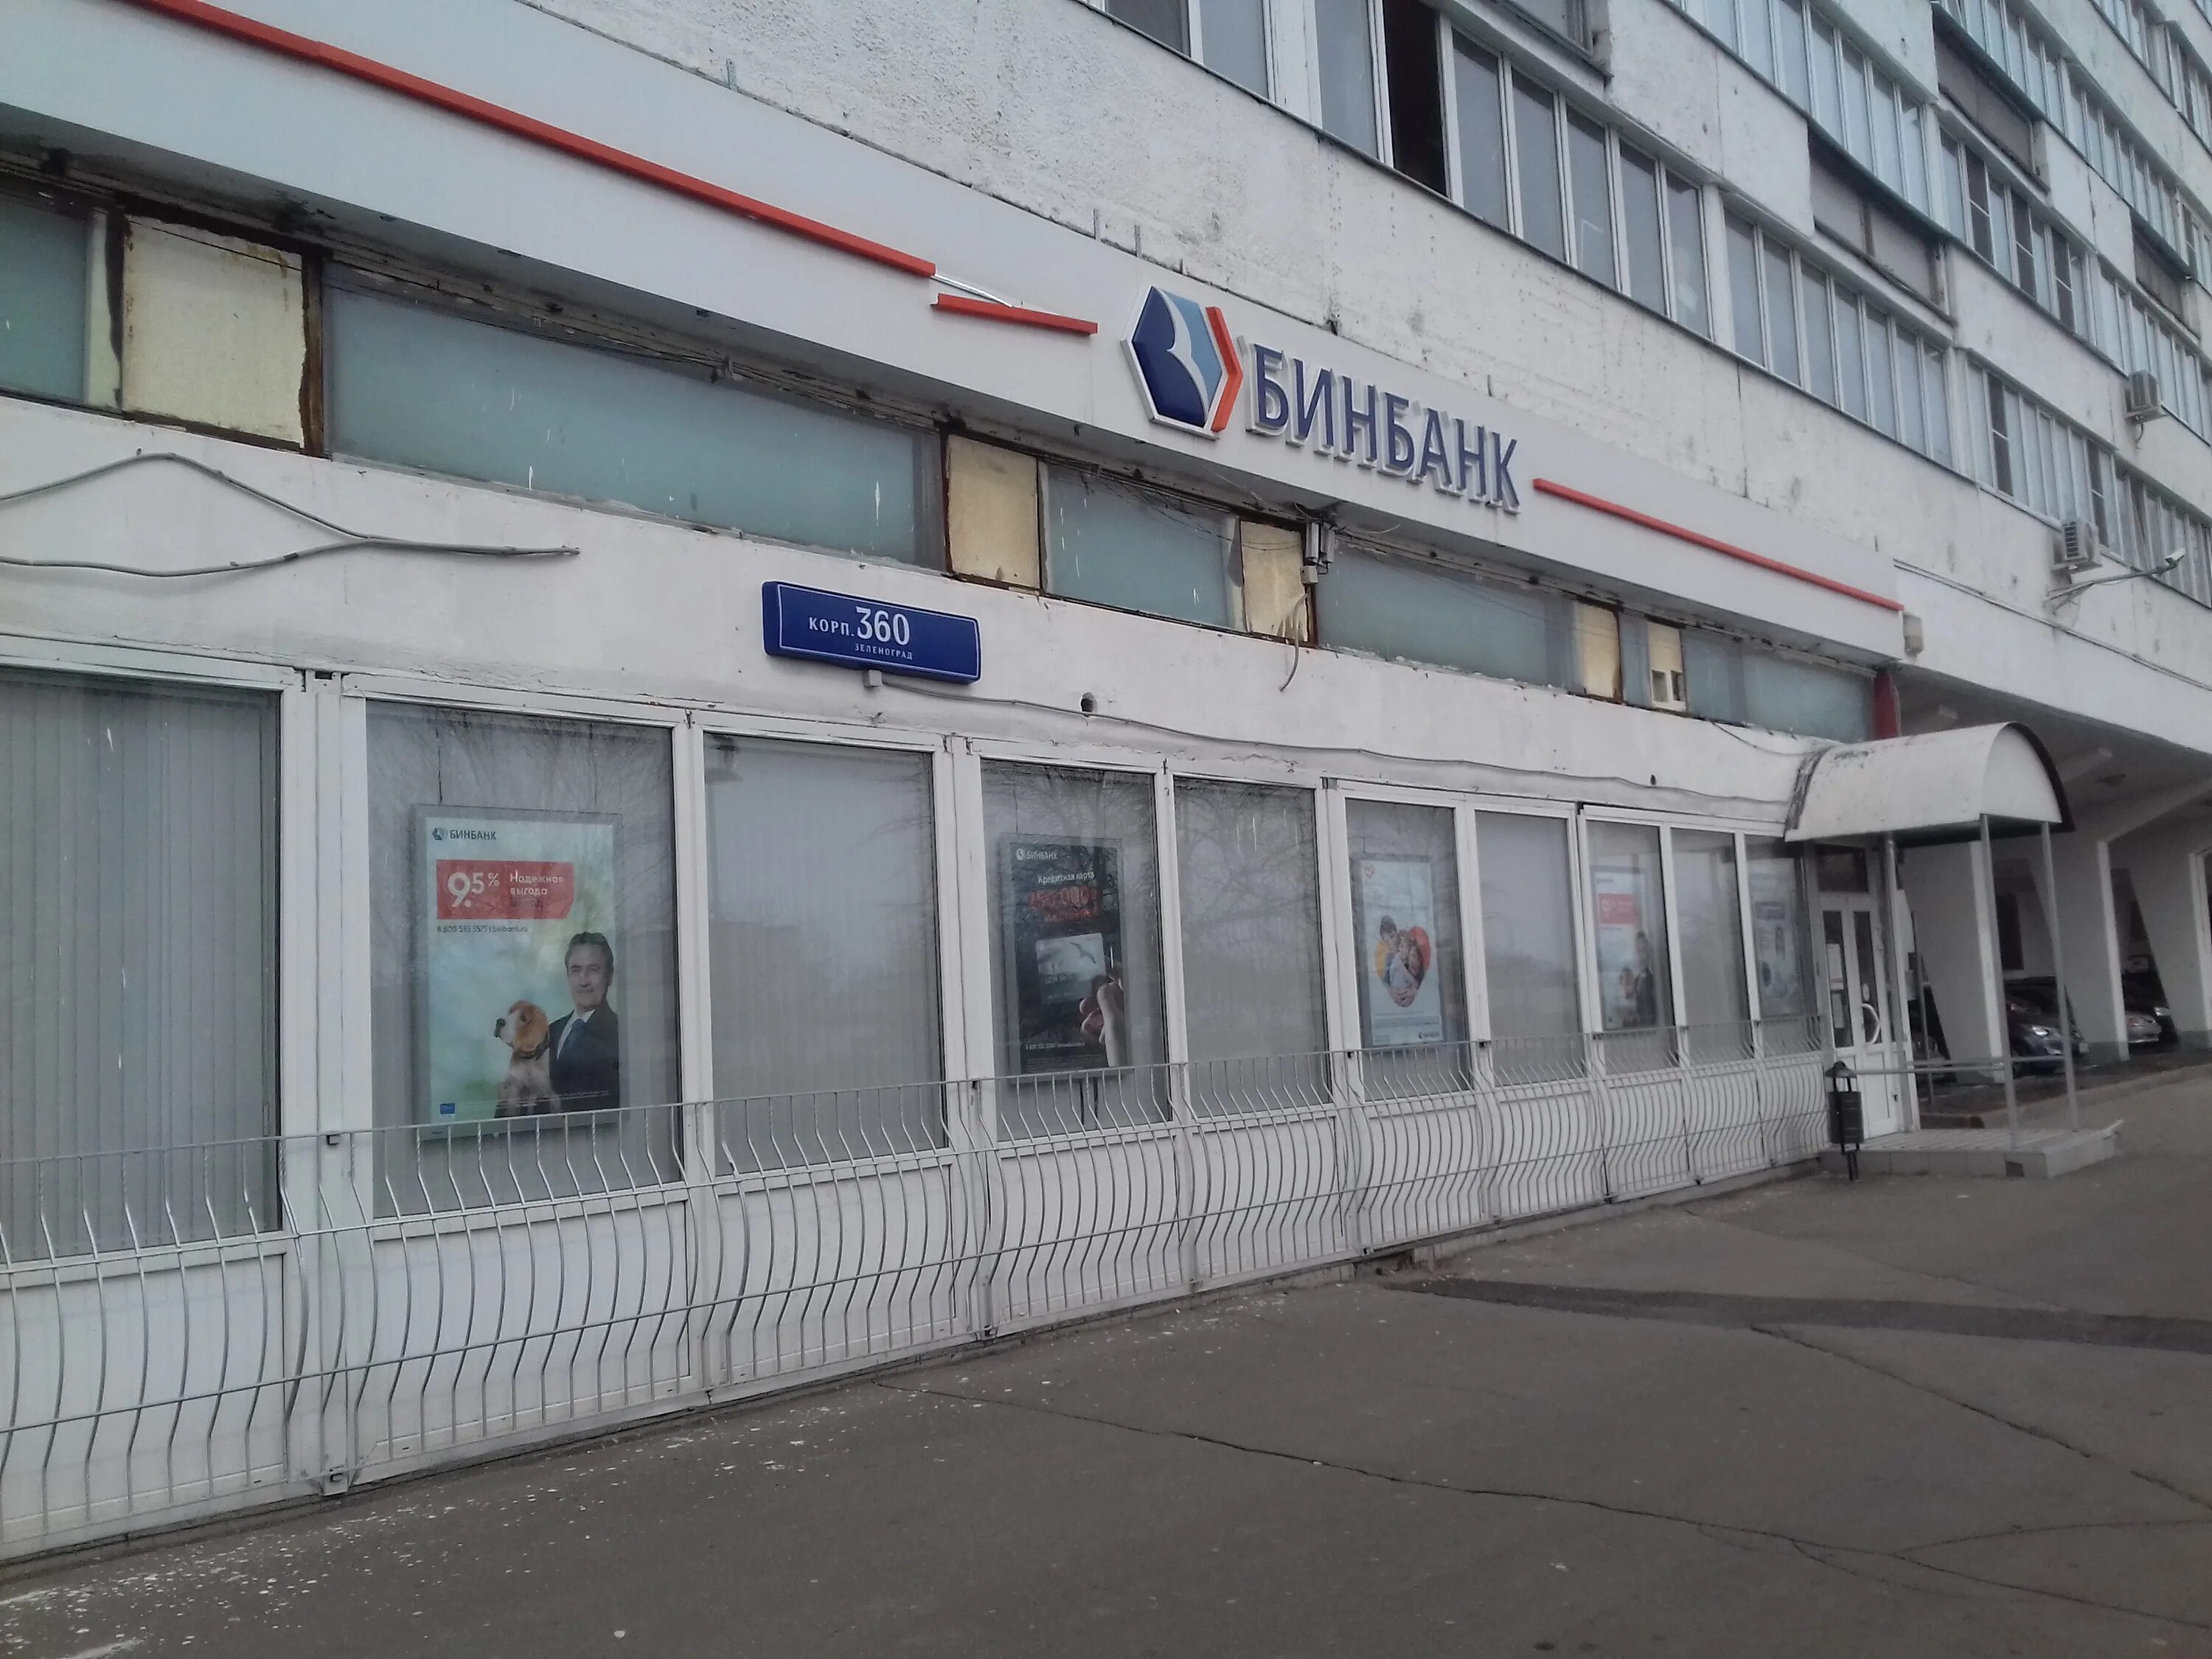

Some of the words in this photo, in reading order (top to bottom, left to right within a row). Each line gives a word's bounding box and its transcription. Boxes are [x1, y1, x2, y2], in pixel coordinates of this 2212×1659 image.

[1249, 342, 1522, 513] БИНБАНК
[809, 616, 855, 637] КОРП.
[856, 605, 911, 646] 360
[854, 643, 914, 661] ЗЕЛЕНОГРАД
[449, 830, 497, 841] БИНБАНК
[509, 872, 564, 884] Надежная
[1037, 874, 1076, 885] Кредитная
[510, 887, 548, 897] выгода
